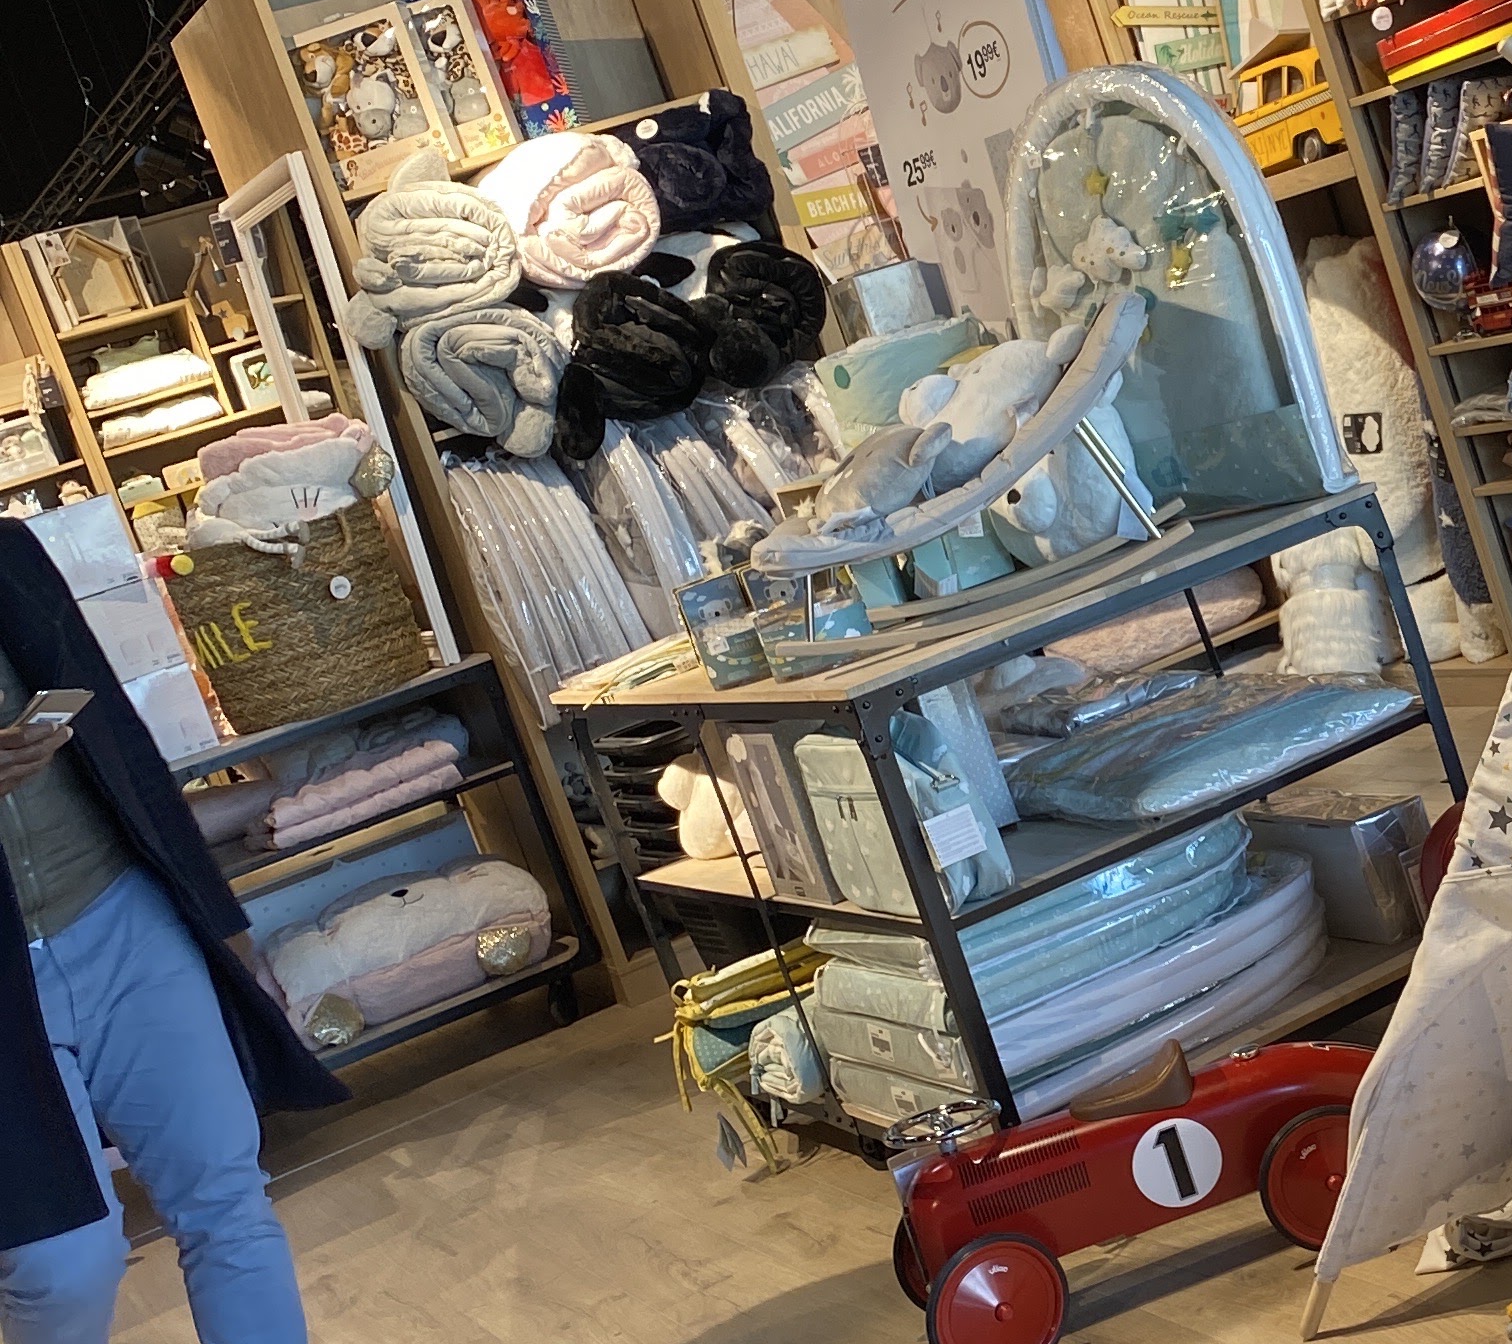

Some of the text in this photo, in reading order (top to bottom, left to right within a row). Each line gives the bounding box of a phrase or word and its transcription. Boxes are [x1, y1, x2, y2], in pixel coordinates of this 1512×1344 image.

[1126, 10, 1200, 20] Ocean Rescue
[767, 86, 848, 142] ALIFORNIA
[807, 194, 848, 218] BEACH
[1152, 1123, 1199, 1202] 1
